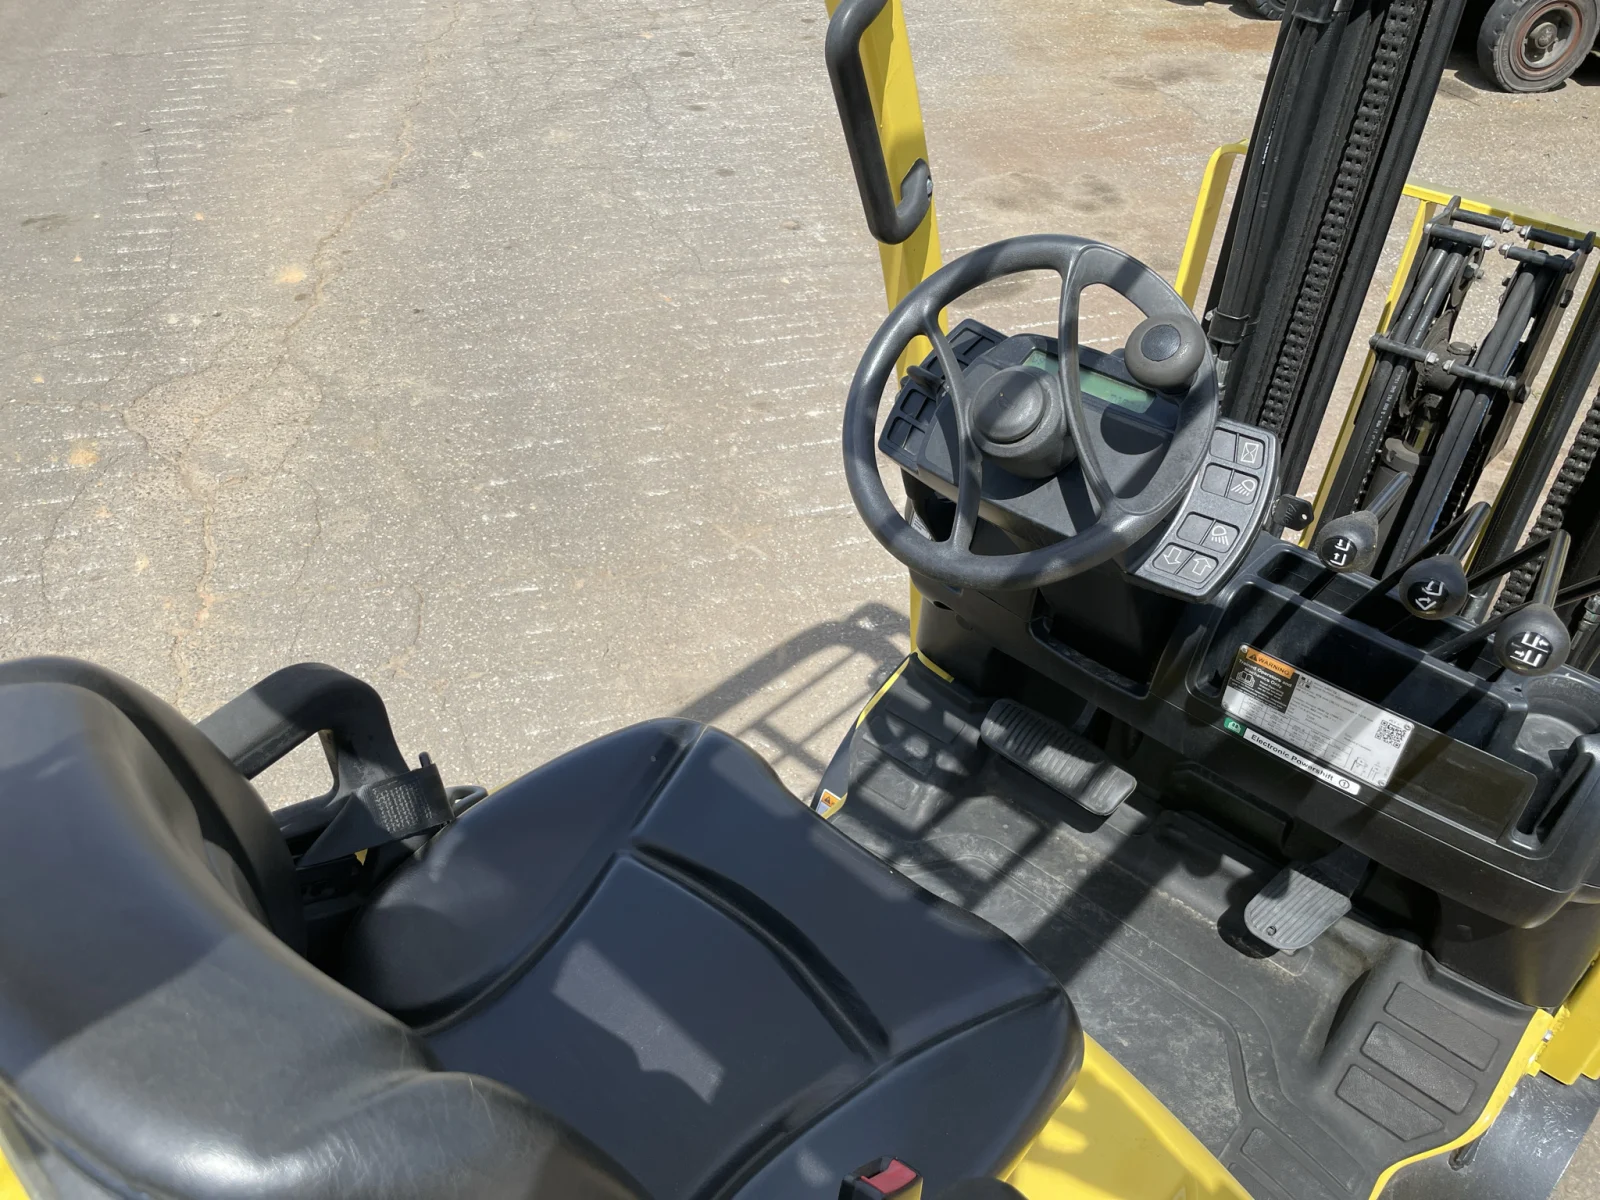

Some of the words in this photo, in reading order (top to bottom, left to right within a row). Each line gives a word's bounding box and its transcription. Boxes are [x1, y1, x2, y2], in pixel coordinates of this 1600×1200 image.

[1239, 659, 1257, 671] Trained
[1257, 668, 1281, 683] Operators
[1244, 667, 1269, 683] Mechanics
[1270, 680, 1282, 689] Only
[1258, 658, 1290, 676] WARNING
[1251, 734, 1290, 757] Electronic
[1291, 755, 1334, 781] Powershift
